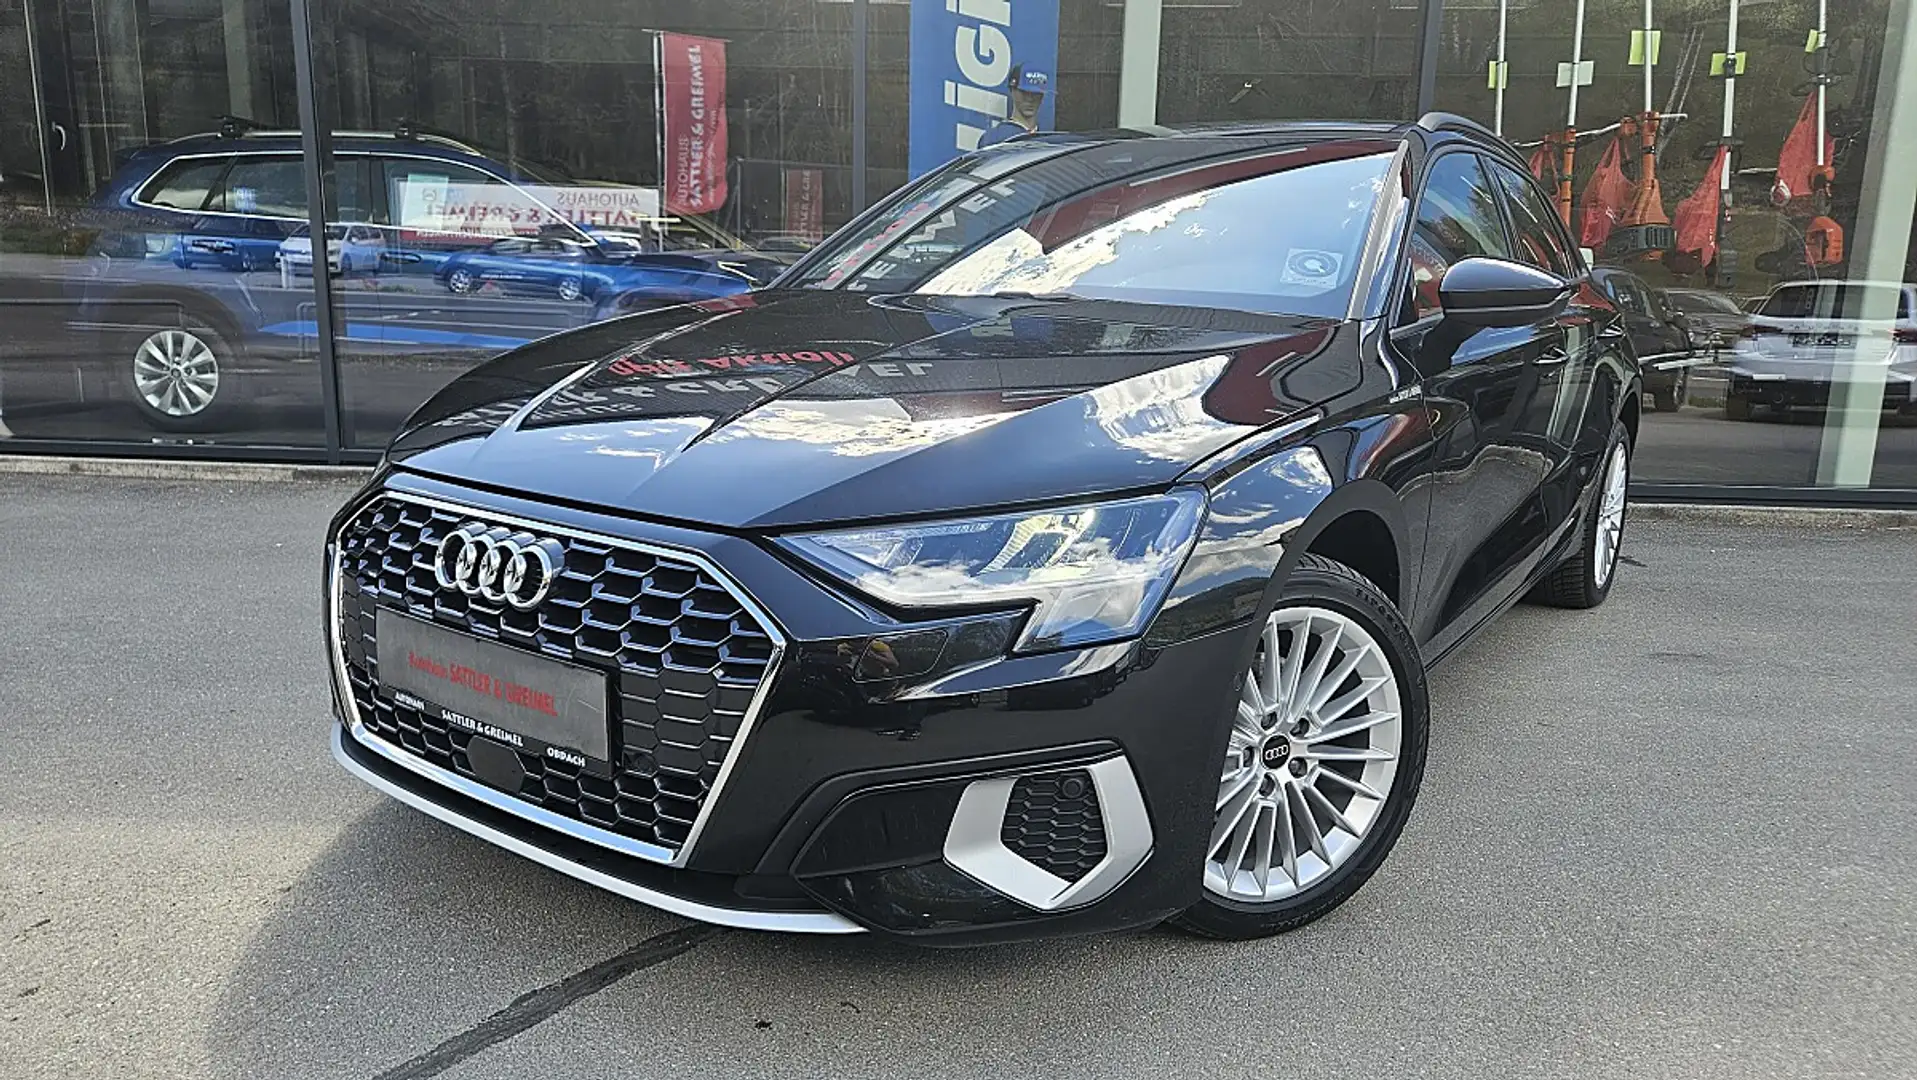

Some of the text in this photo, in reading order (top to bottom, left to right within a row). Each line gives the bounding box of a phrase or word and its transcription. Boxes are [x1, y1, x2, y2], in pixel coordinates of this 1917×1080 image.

[688, 45, 704, 120] GREIMEL
[689, 138, 704, 207] SATTLER
[449, 662, 492, 696] SATTLER
[493, 678, 503, 700] &
[504, 681, 559, 717] GREIMEL
[441, 709, 477, 731] SATTLER
[484, 725, 524, 748] GREIMEL
[546, 746, 586, 768] OBDACH
